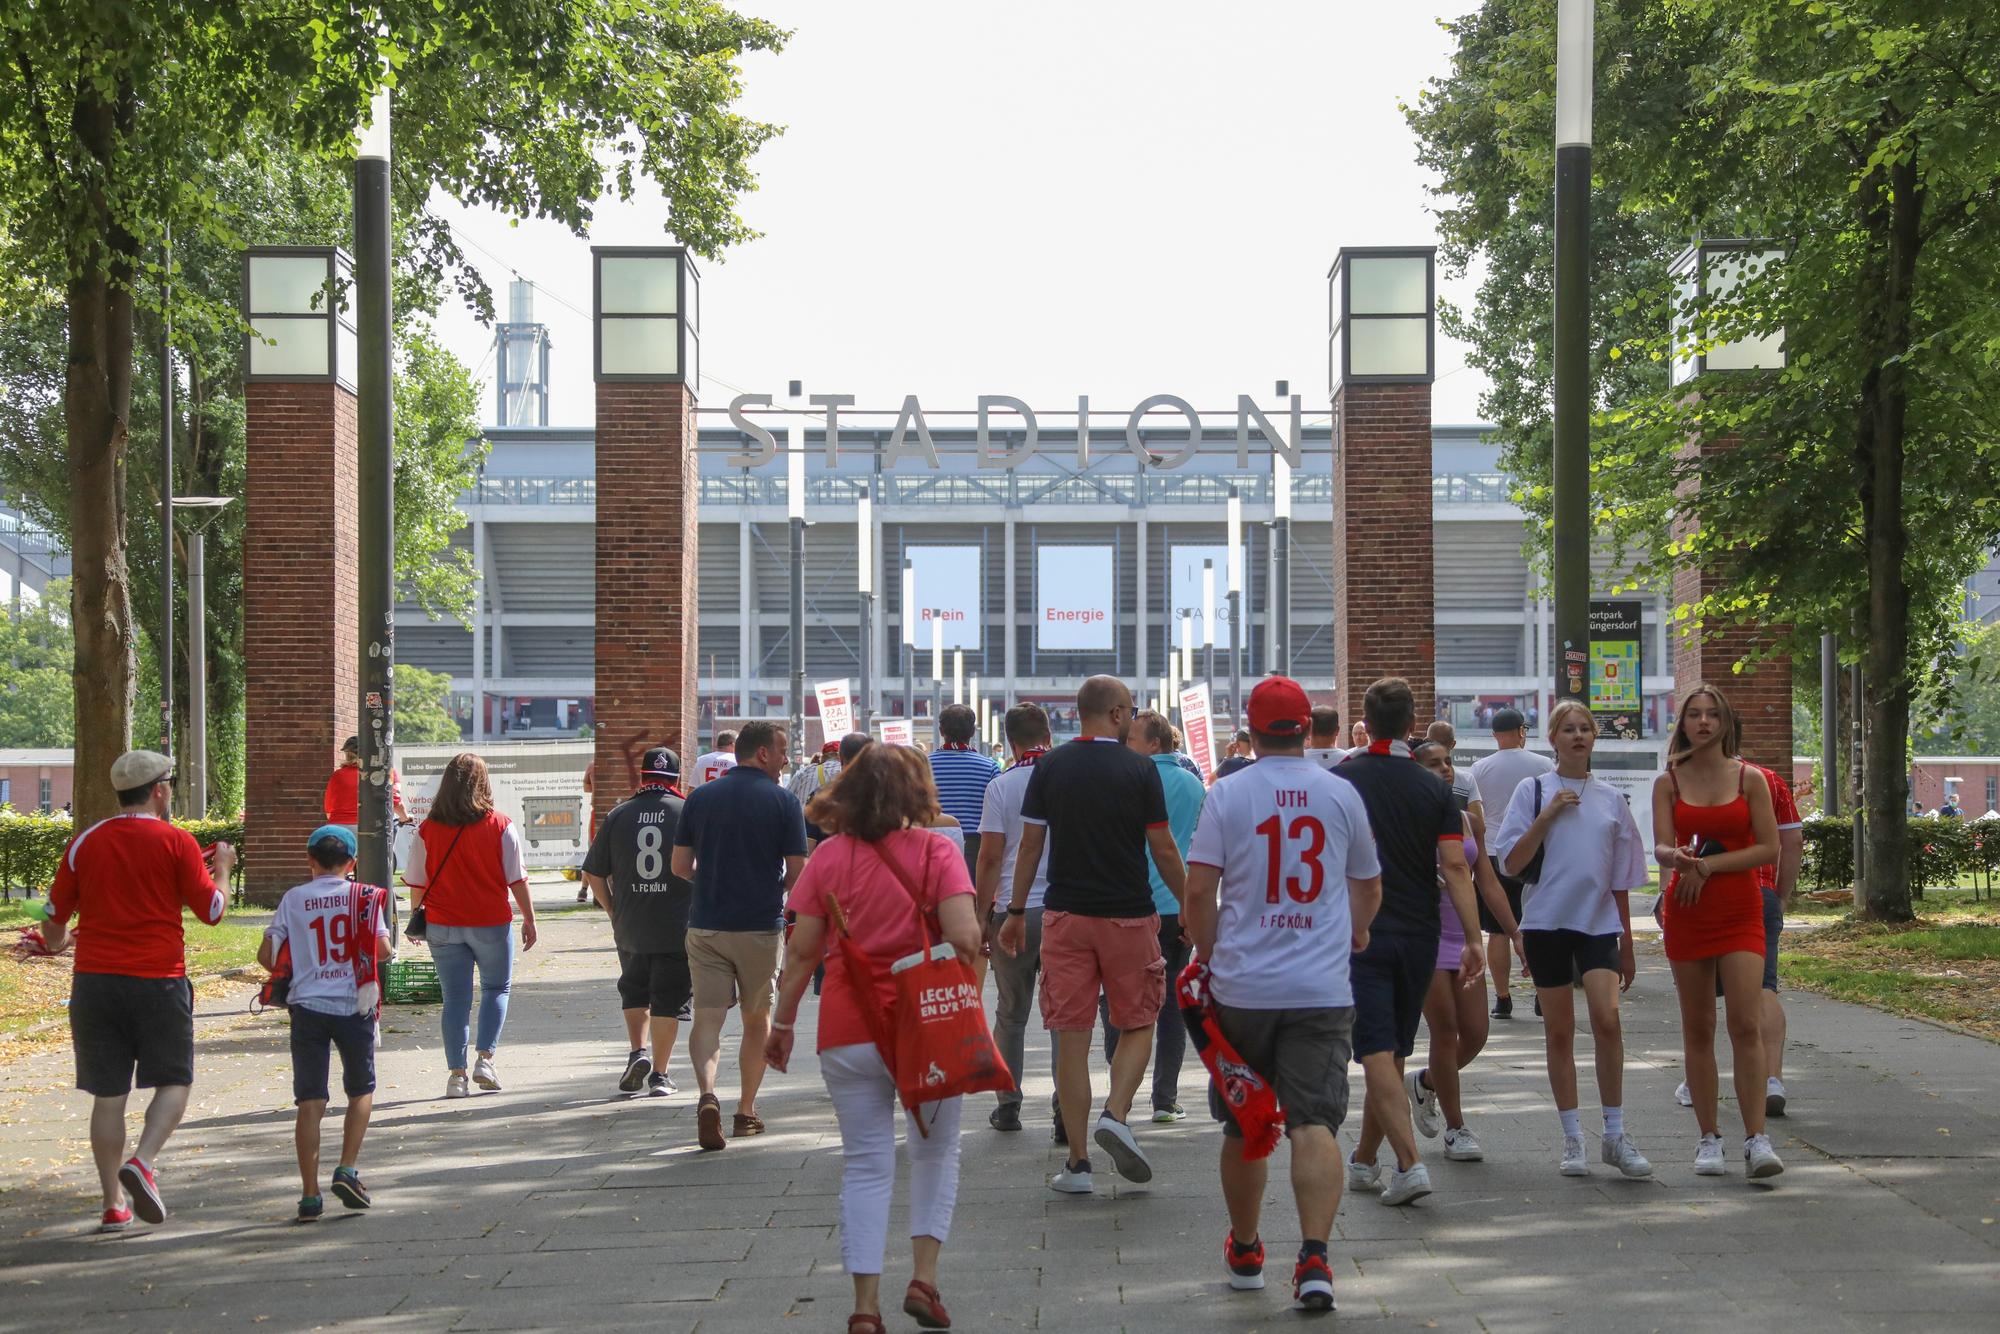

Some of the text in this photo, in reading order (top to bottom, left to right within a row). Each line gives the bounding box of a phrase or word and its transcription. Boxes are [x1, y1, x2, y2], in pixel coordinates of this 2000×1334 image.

[726, 394, 1301, 469] STADION
[921, 607, 1104, 624] Rein Energie
[1589, 610, 1622, 621] ortpark
[1589, 621, 1638, 632] üngersdorf
[408, 796, 432, 804] Verbo
[1276, 790, 1308, 808] UTH
[637, 809, 665, 824] JOJIĆ
[636, 825, 663, 880] 8
[1255, 814, 1326, 904] 13
[631, 882, 667, 893] 1. FC KÖLN
[304, 895, 349, 912] EHIZIBU
[1270, 914, 1285, 928] FC
[1287, 912, 1312, 929] KÖLN
[308, 913, 352, 967] 19
[320, 971, 330, 979] FC
[330, 969, 348, 979] KÖLN
[919, 985, 955, 1006] LECK
[920, 1003, 937, 1018] EN
[939, 1002, 959, 1015] D'R
